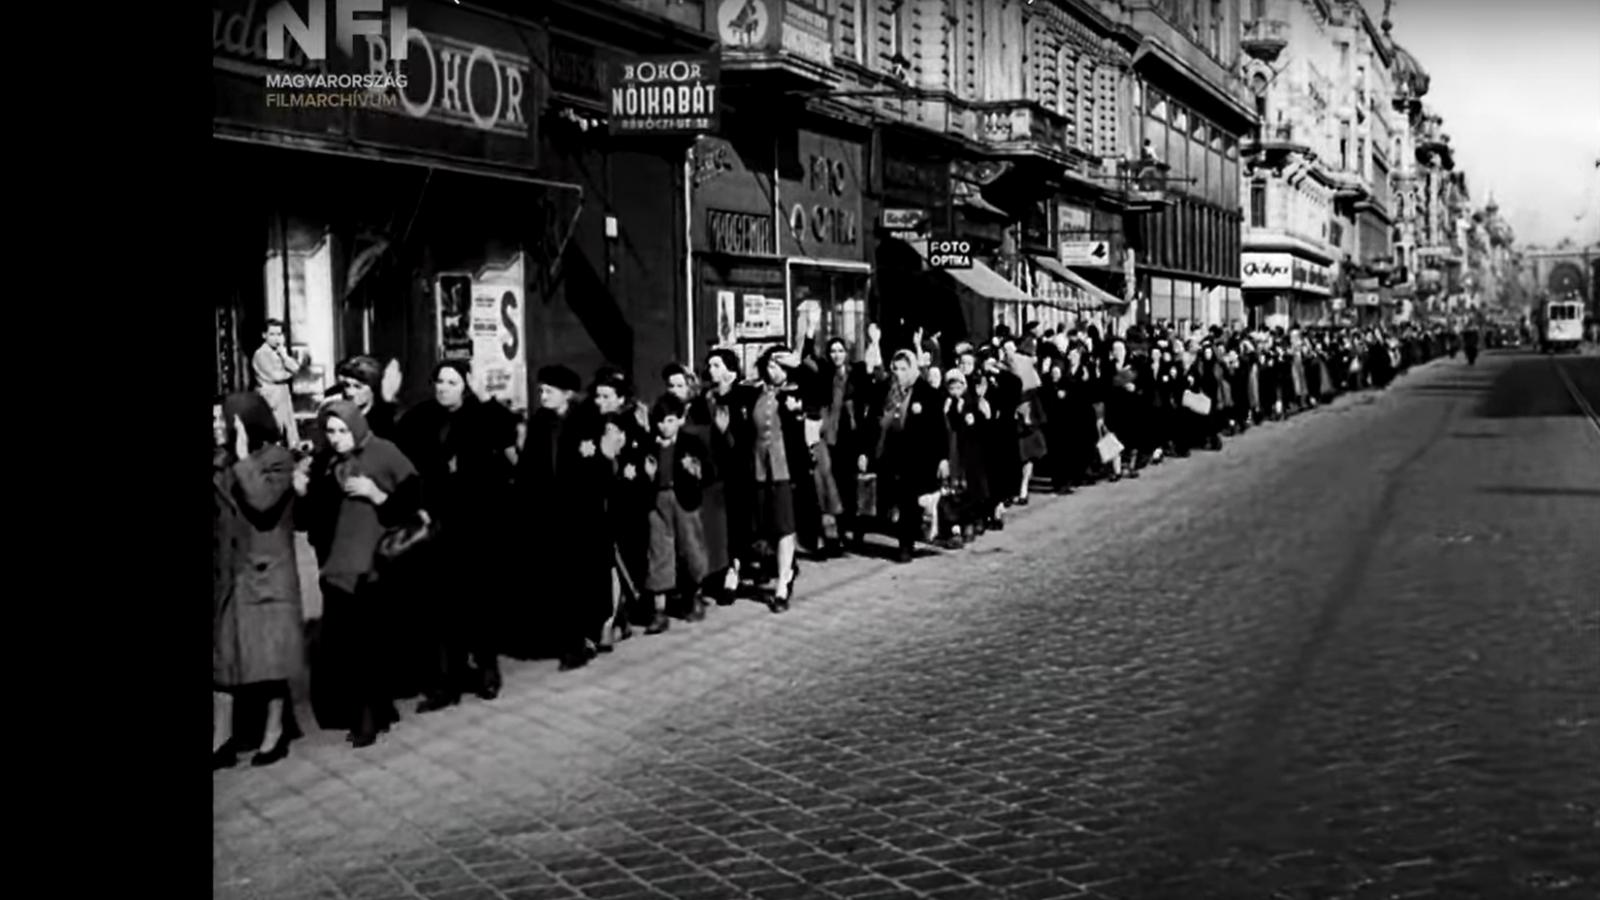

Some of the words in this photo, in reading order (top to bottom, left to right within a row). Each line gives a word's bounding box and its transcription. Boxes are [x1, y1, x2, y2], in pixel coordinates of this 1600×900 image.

[624, 60, 701, 83] BOKOR
[929, 240, 971, 254] FOTO
[929, 254, 971, 267] OPTIKA
[500, 290, 519, 361] S
